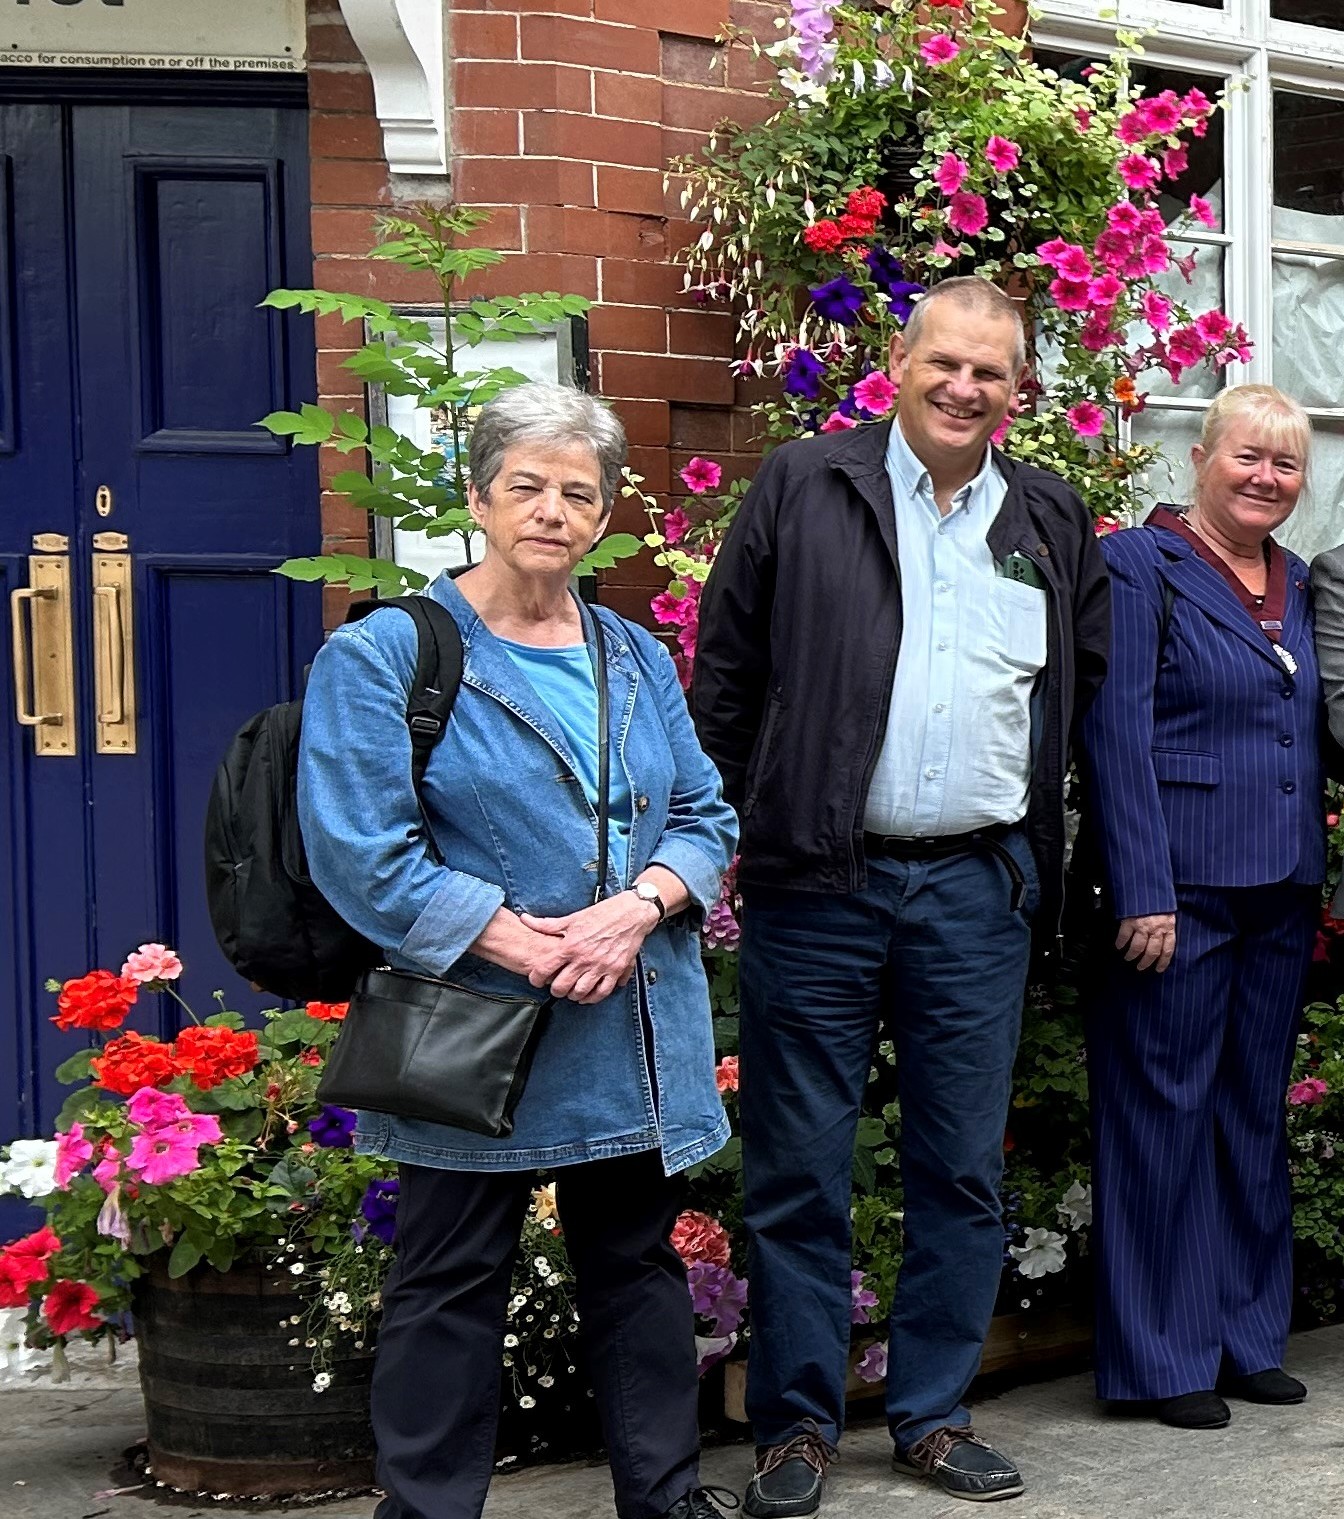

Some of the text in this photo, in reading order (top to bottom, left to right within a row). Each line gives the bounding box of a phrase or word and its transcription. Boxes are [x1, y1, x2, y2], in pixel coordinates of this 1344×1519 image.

[38, 53, 56, 64] for
[60, 54, 146, 67] consumption
[149, 57, 165, 66] on
[169, 57, 183, 67] or
[186, 56, 204, 68] off
[209, 57, 230, 68] the
